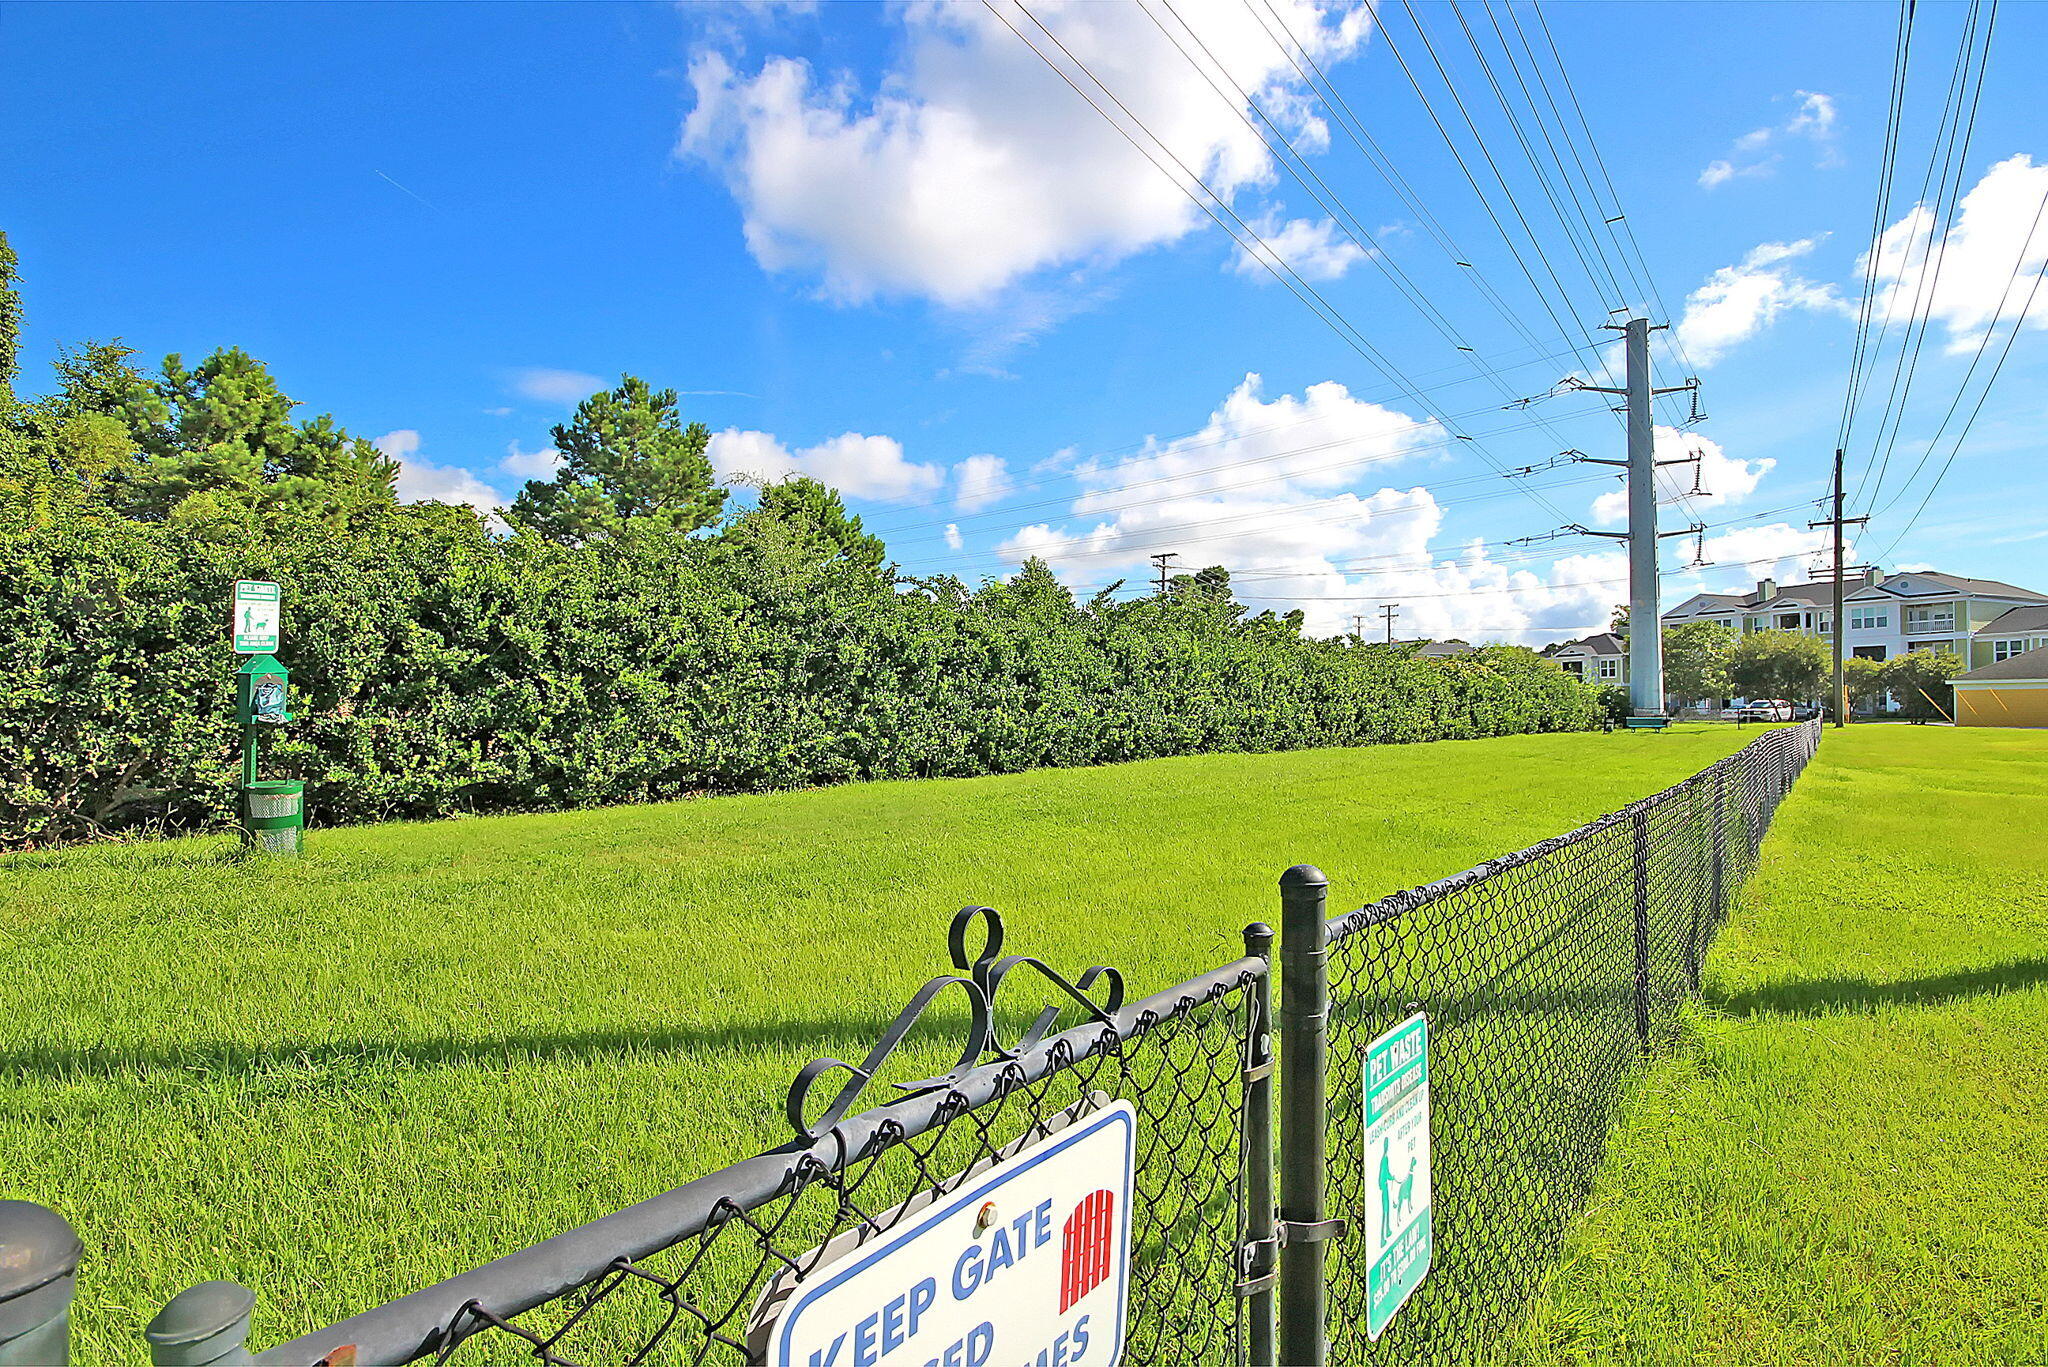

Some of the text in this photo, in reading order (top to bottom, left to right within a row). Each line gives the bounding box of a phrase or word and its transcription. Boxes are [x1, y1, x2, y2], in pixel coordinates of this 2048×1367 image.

[1370, 1027, 1423, 1087] PET WASTE
[951, 1198, 1053, 1301] GATE
[923, 1320, 995, 1367] ED
